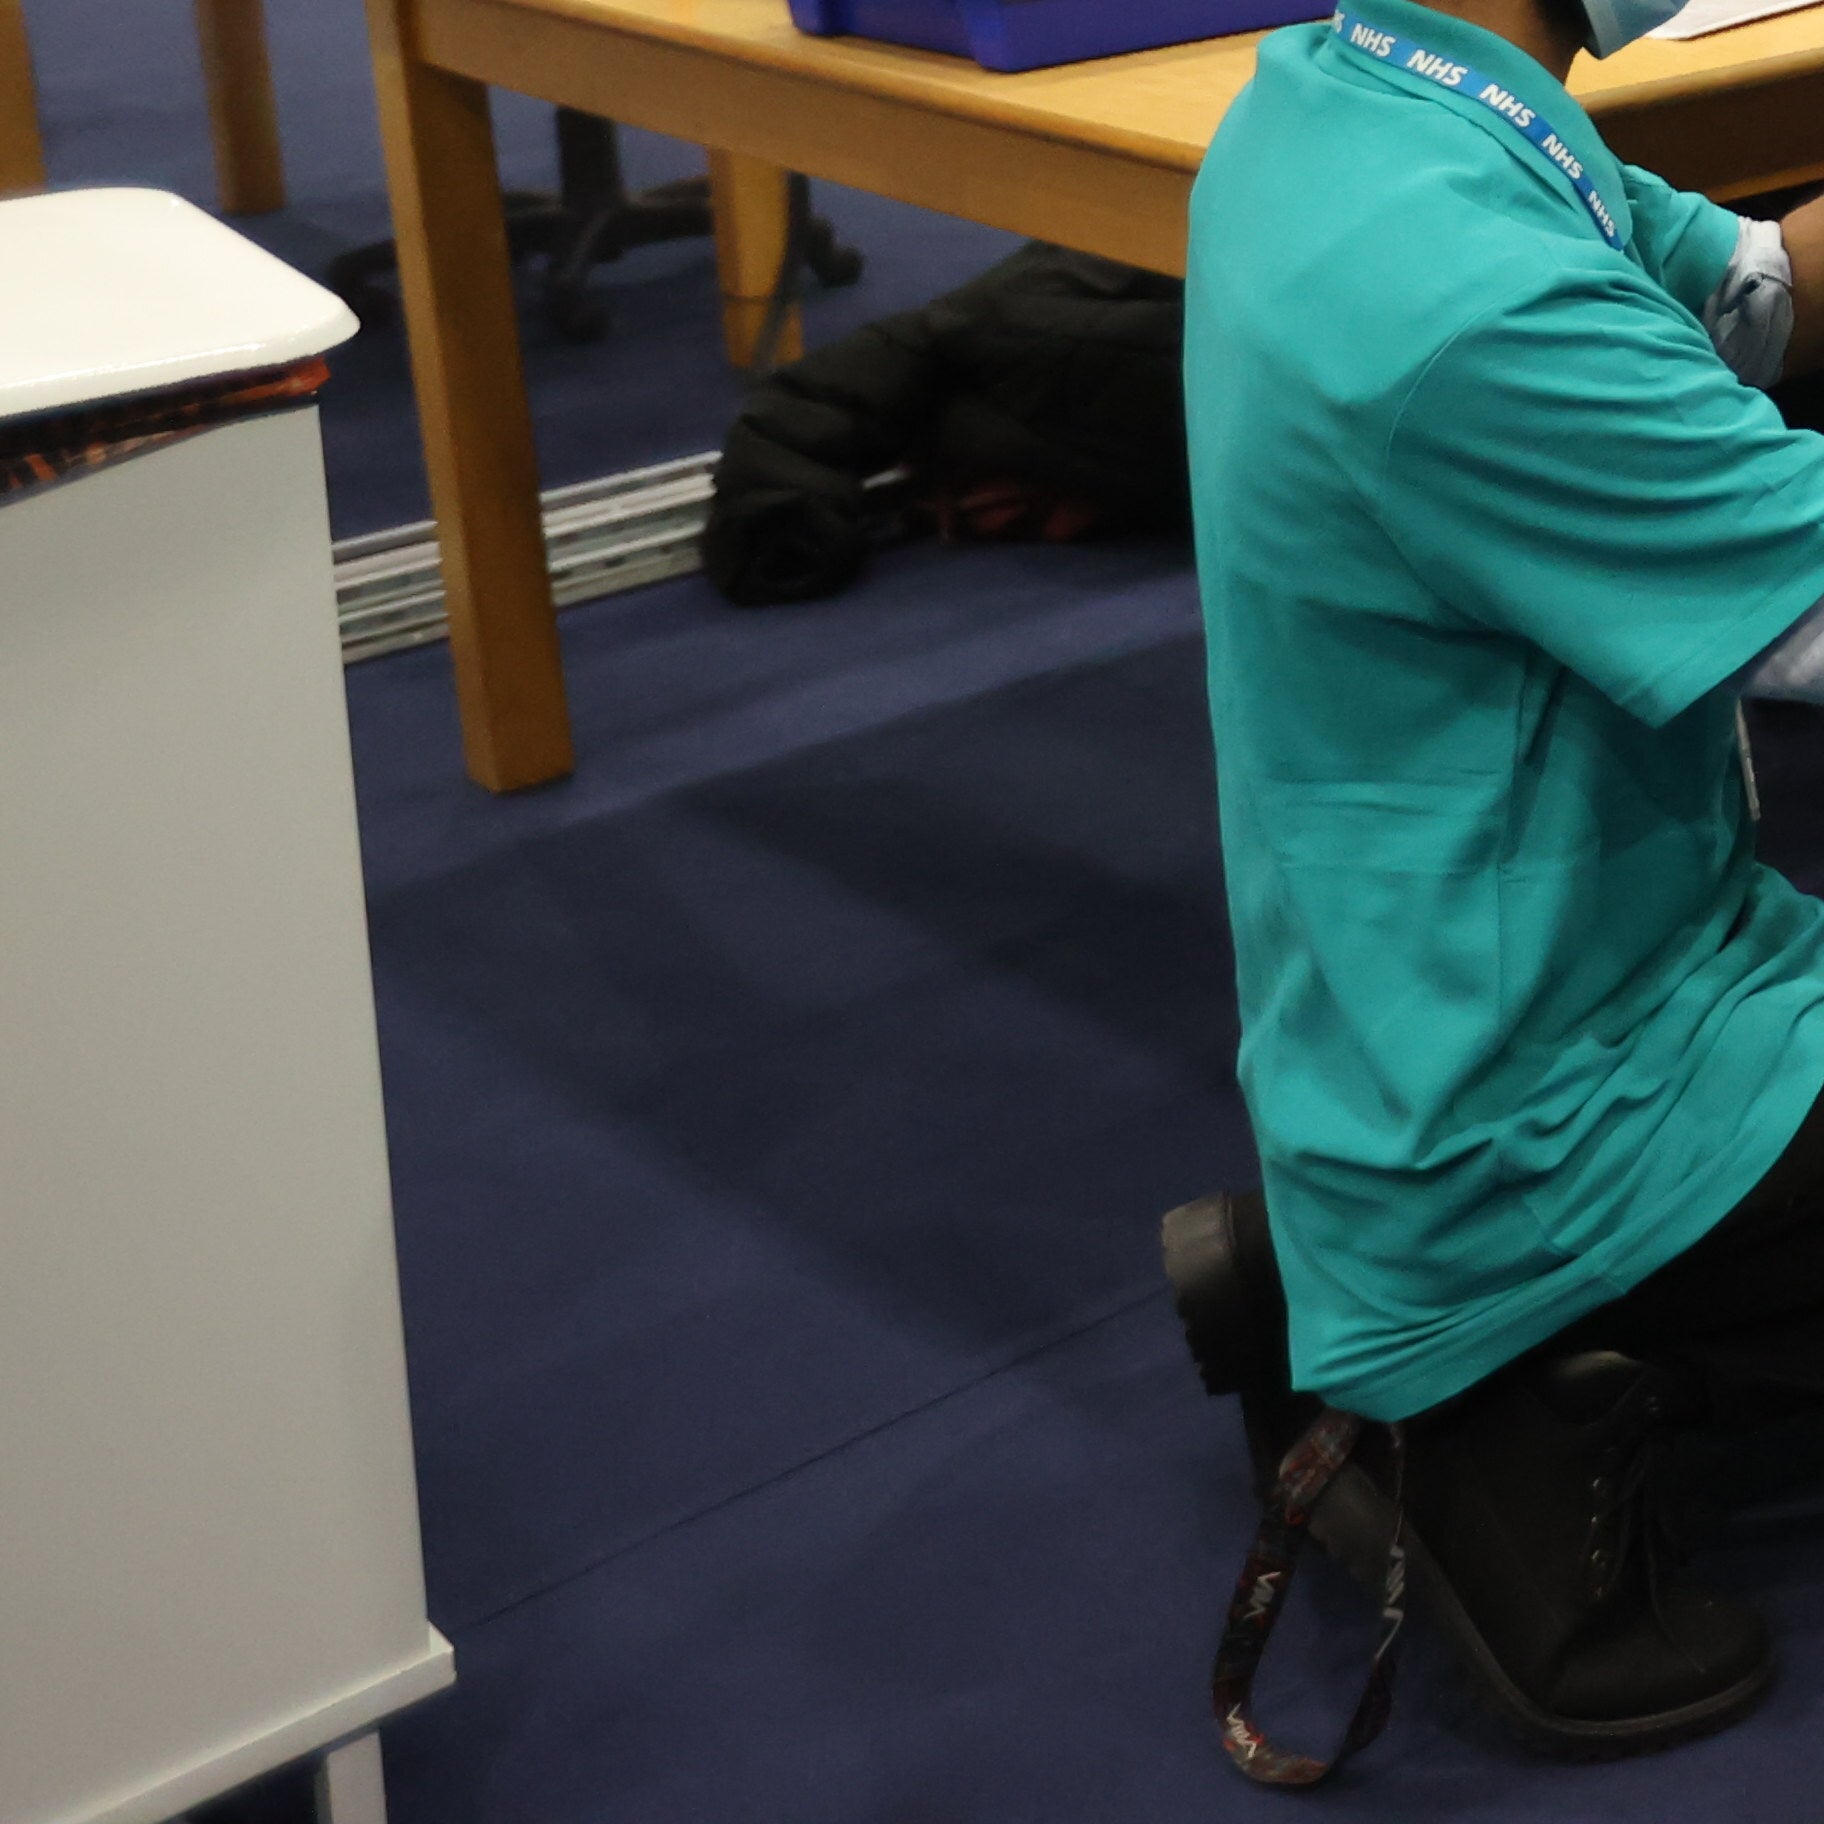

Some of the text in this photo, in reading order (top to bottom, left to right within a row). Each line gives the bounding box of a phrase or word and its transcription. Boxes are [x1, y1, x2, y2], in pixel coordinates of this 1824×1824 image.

[1350, 22, 1616, 238] NHS NHS NHS NHS NHS
